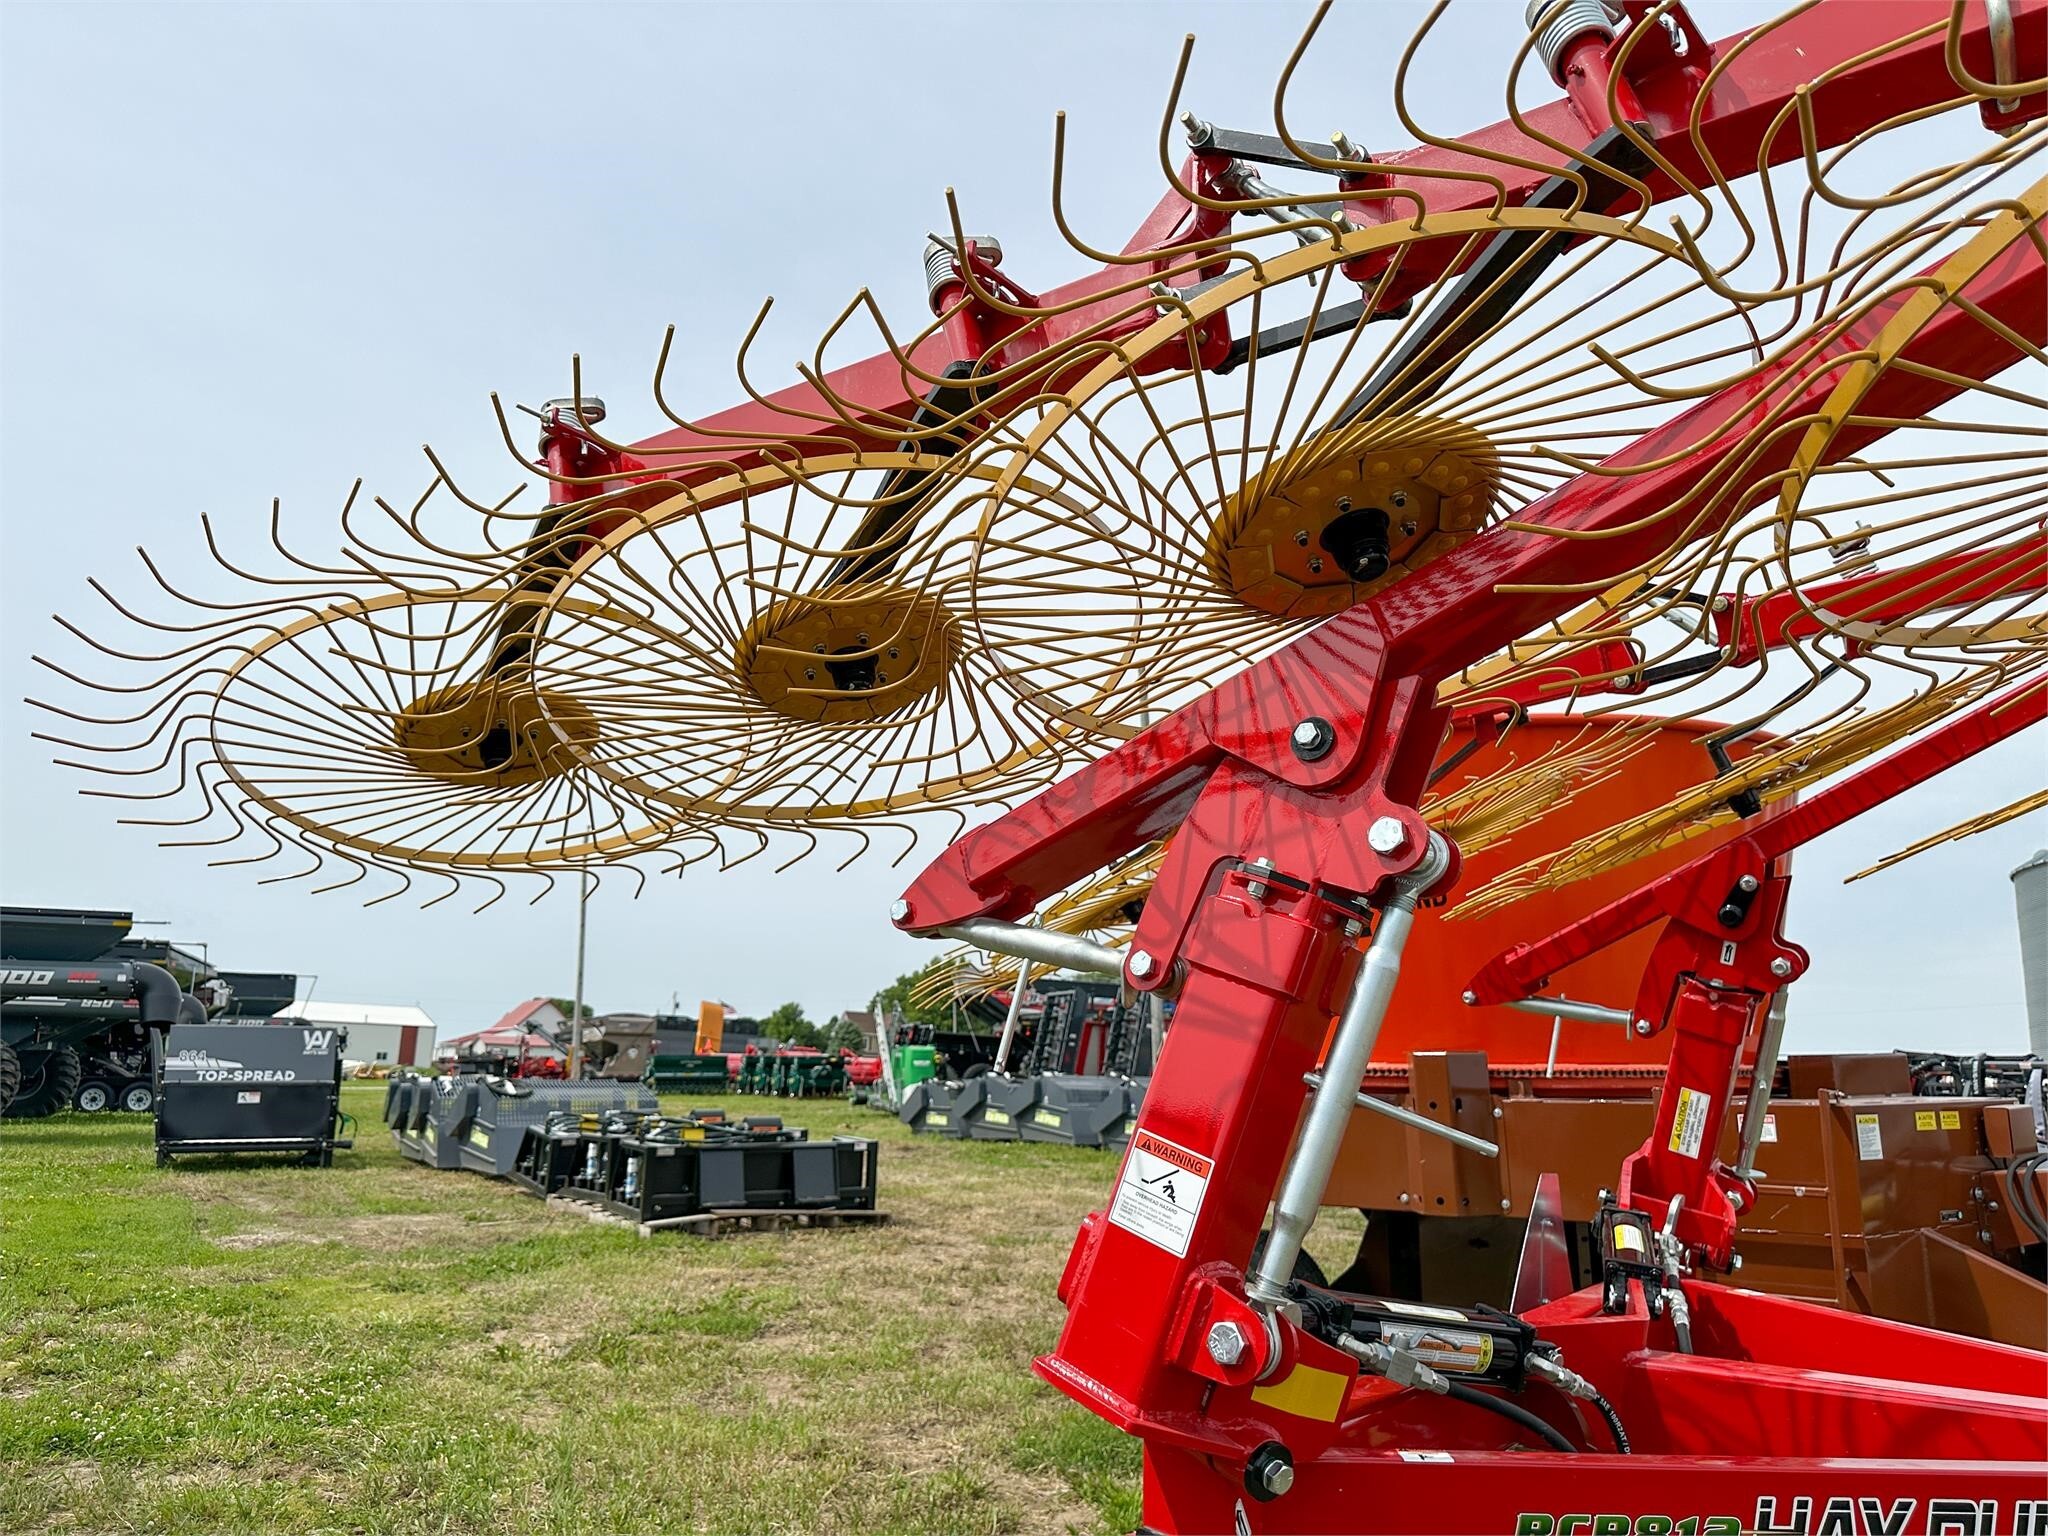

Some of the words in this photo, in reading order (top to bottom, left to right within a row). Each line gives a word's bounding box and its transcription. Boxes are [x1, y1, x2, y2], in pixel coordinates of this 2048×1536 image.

[180, 1050, 207, 1062] 864
[197, 1070, 296, 1082] TOP-SPREAD
[1153, 1142, 1203, 1173] WARNING
[1135, 1191, 1159, 1206] OVERHEAD
[1160, 1203, 1178, 1215] HAZARD
[1753, 1496, 1917, 1536] HAY
